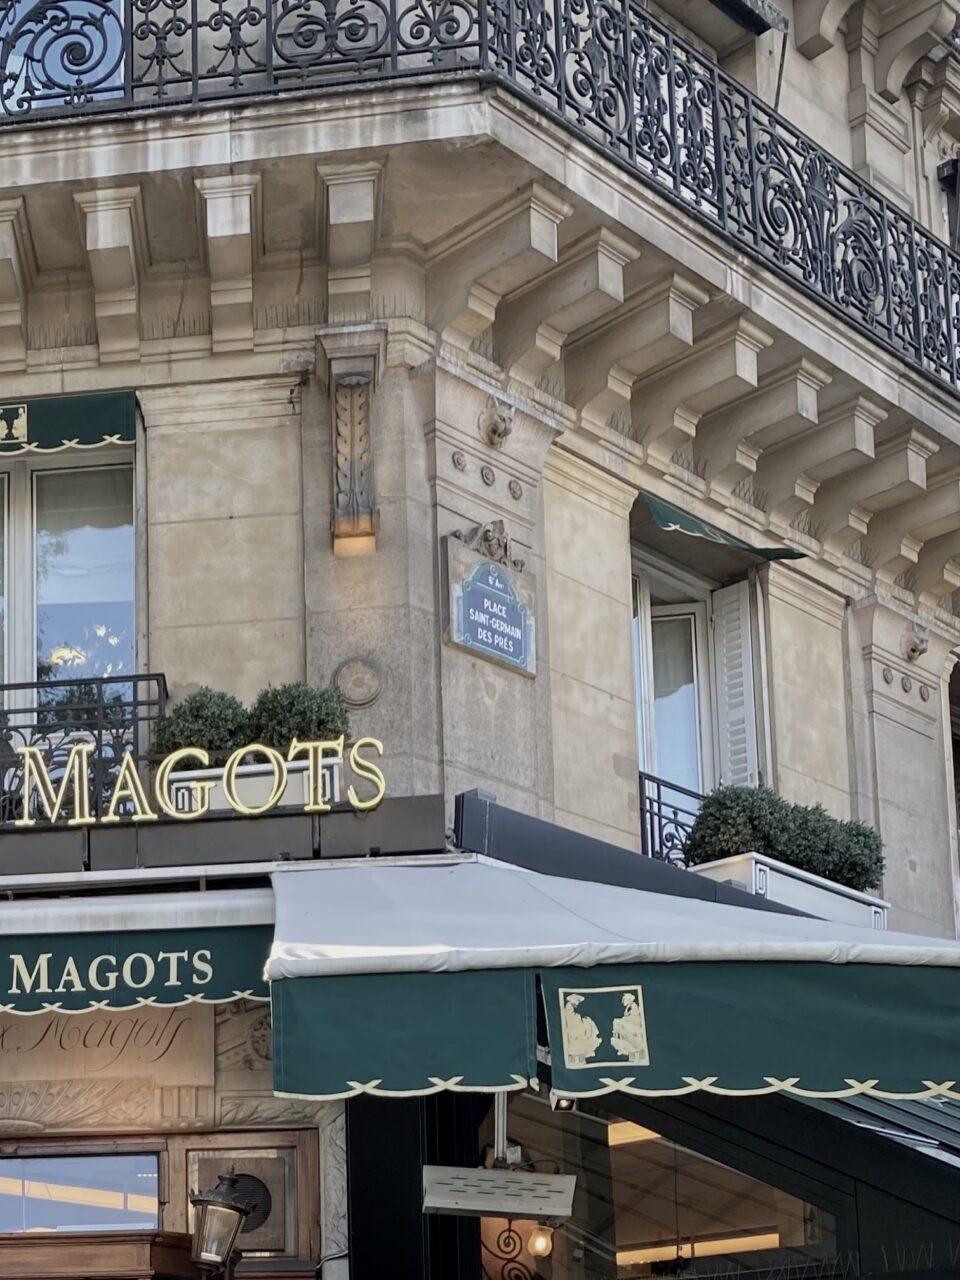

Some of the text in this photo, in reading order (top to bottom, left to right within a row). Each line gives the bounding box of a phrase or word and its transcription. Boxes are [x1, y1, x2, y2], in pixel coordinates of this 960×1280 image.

[469, 608, 522, 640] SAINT-GERMAIN
[483, 598, 507, 618] PLACE
[477, 627, 514, 652] DES PRÉS
[15, 735, 387, 825] MAGOTS
[7, 949, 214, 994] MAGOTS
